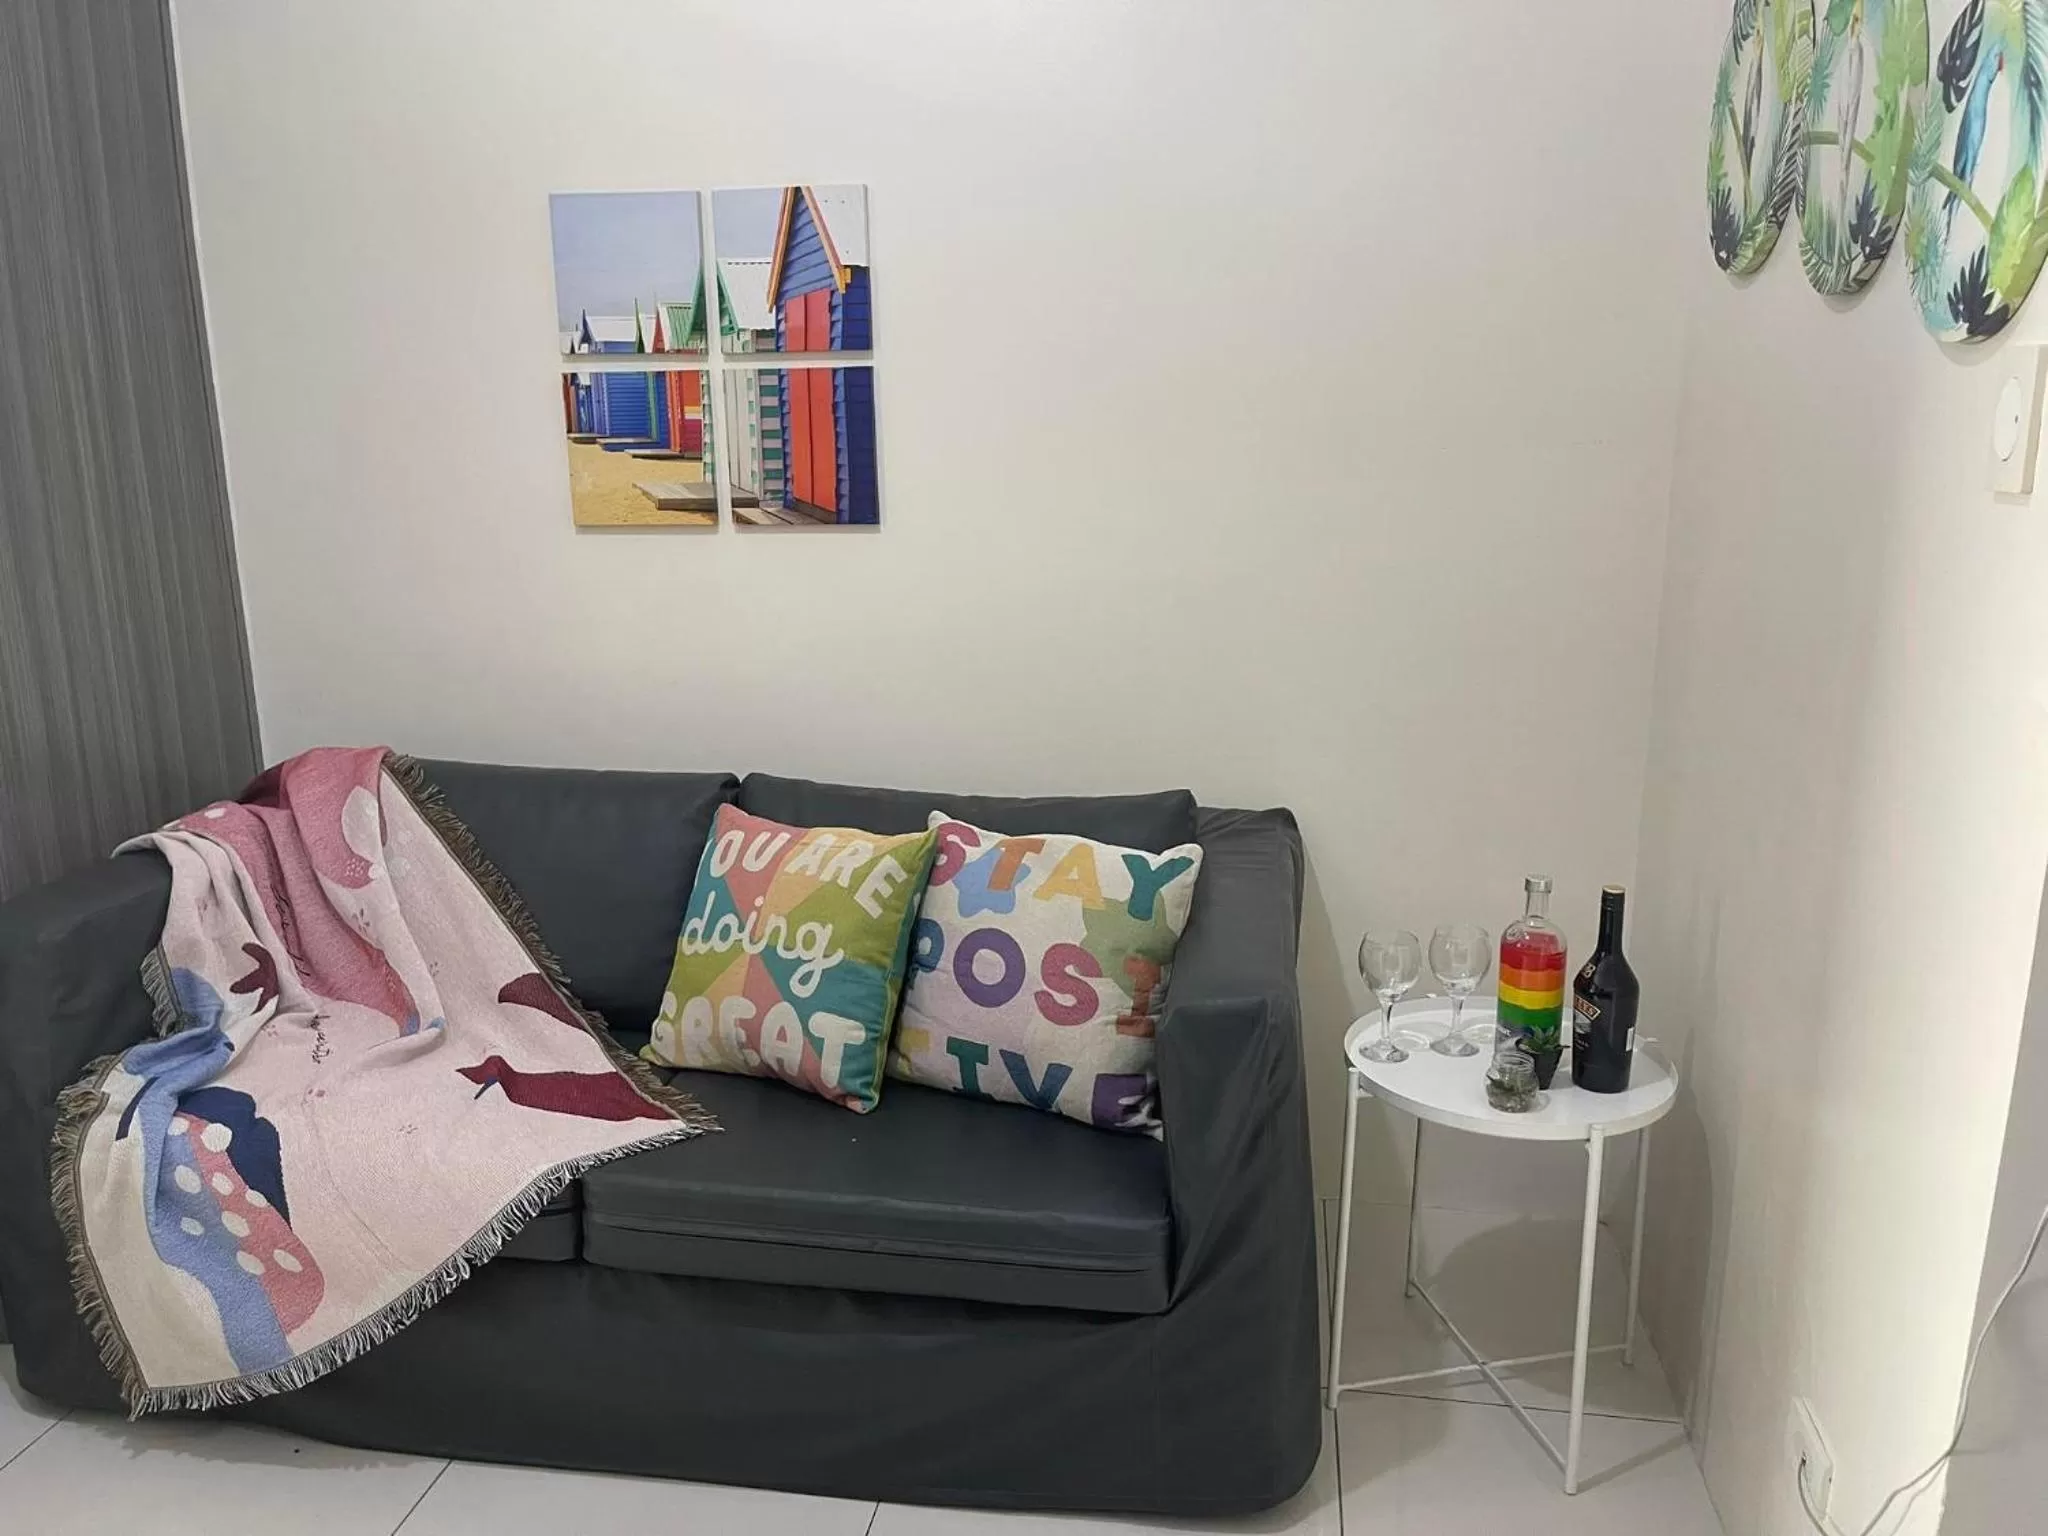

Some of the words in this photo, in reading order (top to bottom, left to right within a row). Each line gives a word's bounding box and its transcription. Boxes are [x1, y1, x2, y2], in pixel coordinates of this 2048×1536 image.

[696, 829, 792, 878] OU
[782, 833, 909, 920] ARE
[928, 821, 1195, 922] STAY
[682, 890, 845, 999] doing
[650, 991, 866, 1089] GREAT
